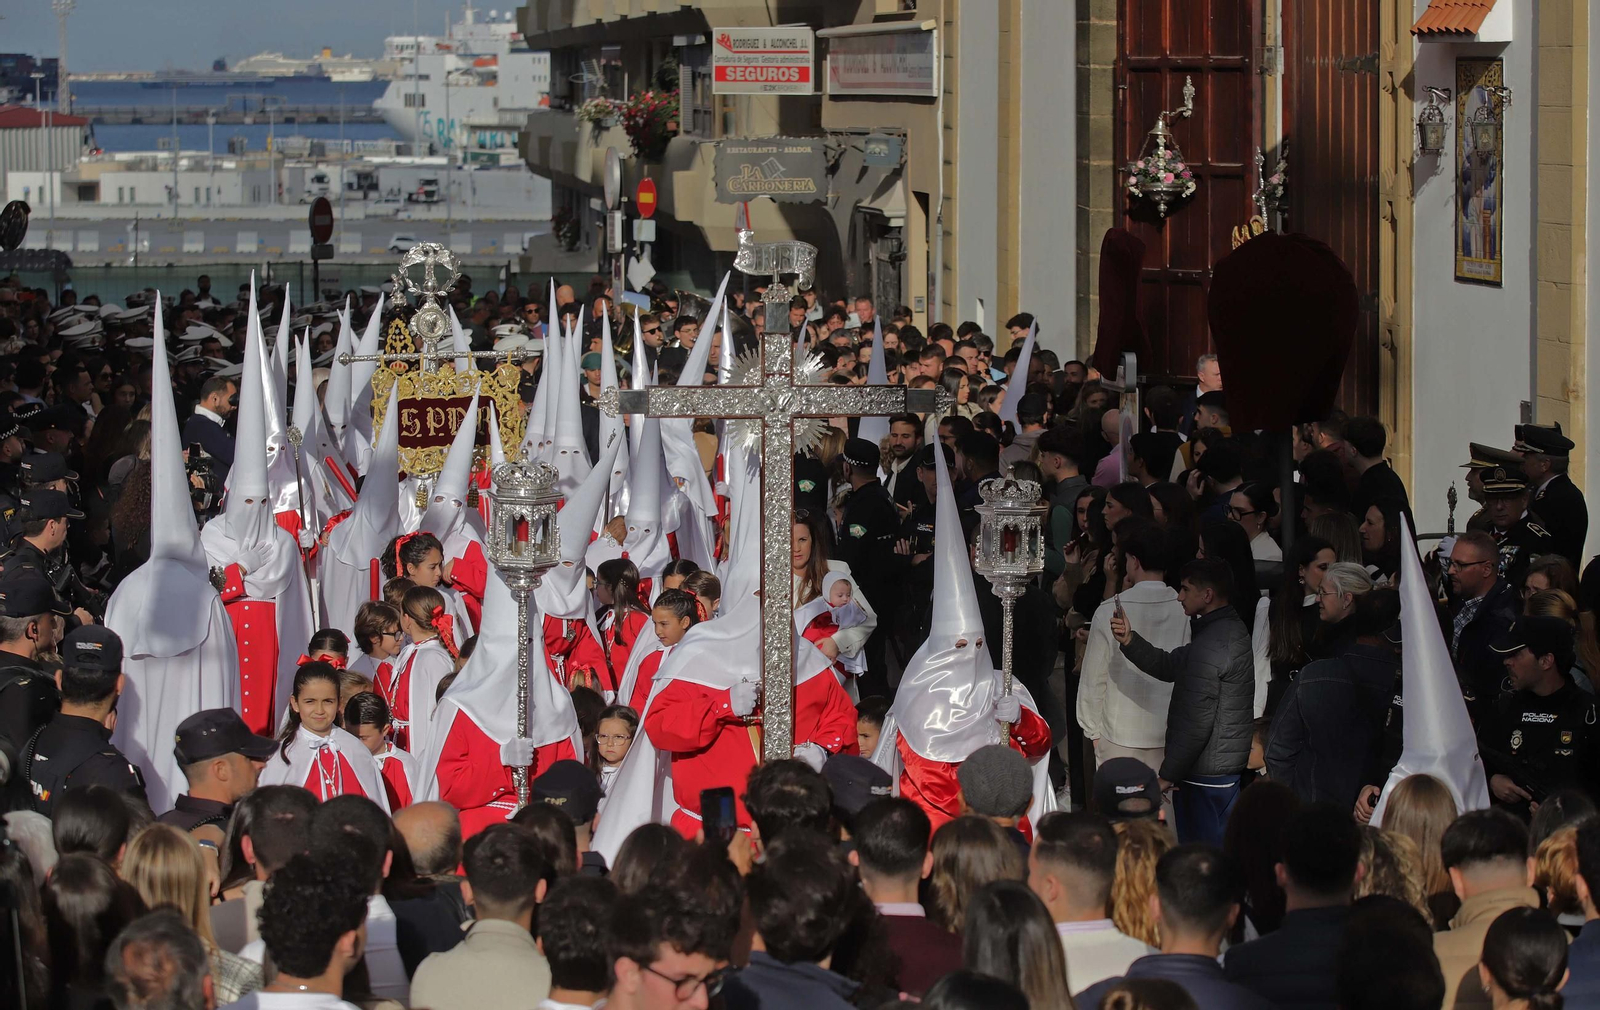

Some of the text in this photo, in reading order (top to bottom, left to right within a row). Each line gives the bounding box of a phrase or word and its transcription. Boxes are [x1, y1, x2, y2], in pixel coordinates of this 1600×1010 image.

[725, 67, 800, 81] SEGUROS
[726, 146, 778, 154] RESTAURANTE
[783, 146, 813, 154] ASADOR
[741, 165, 763, 180] LA
